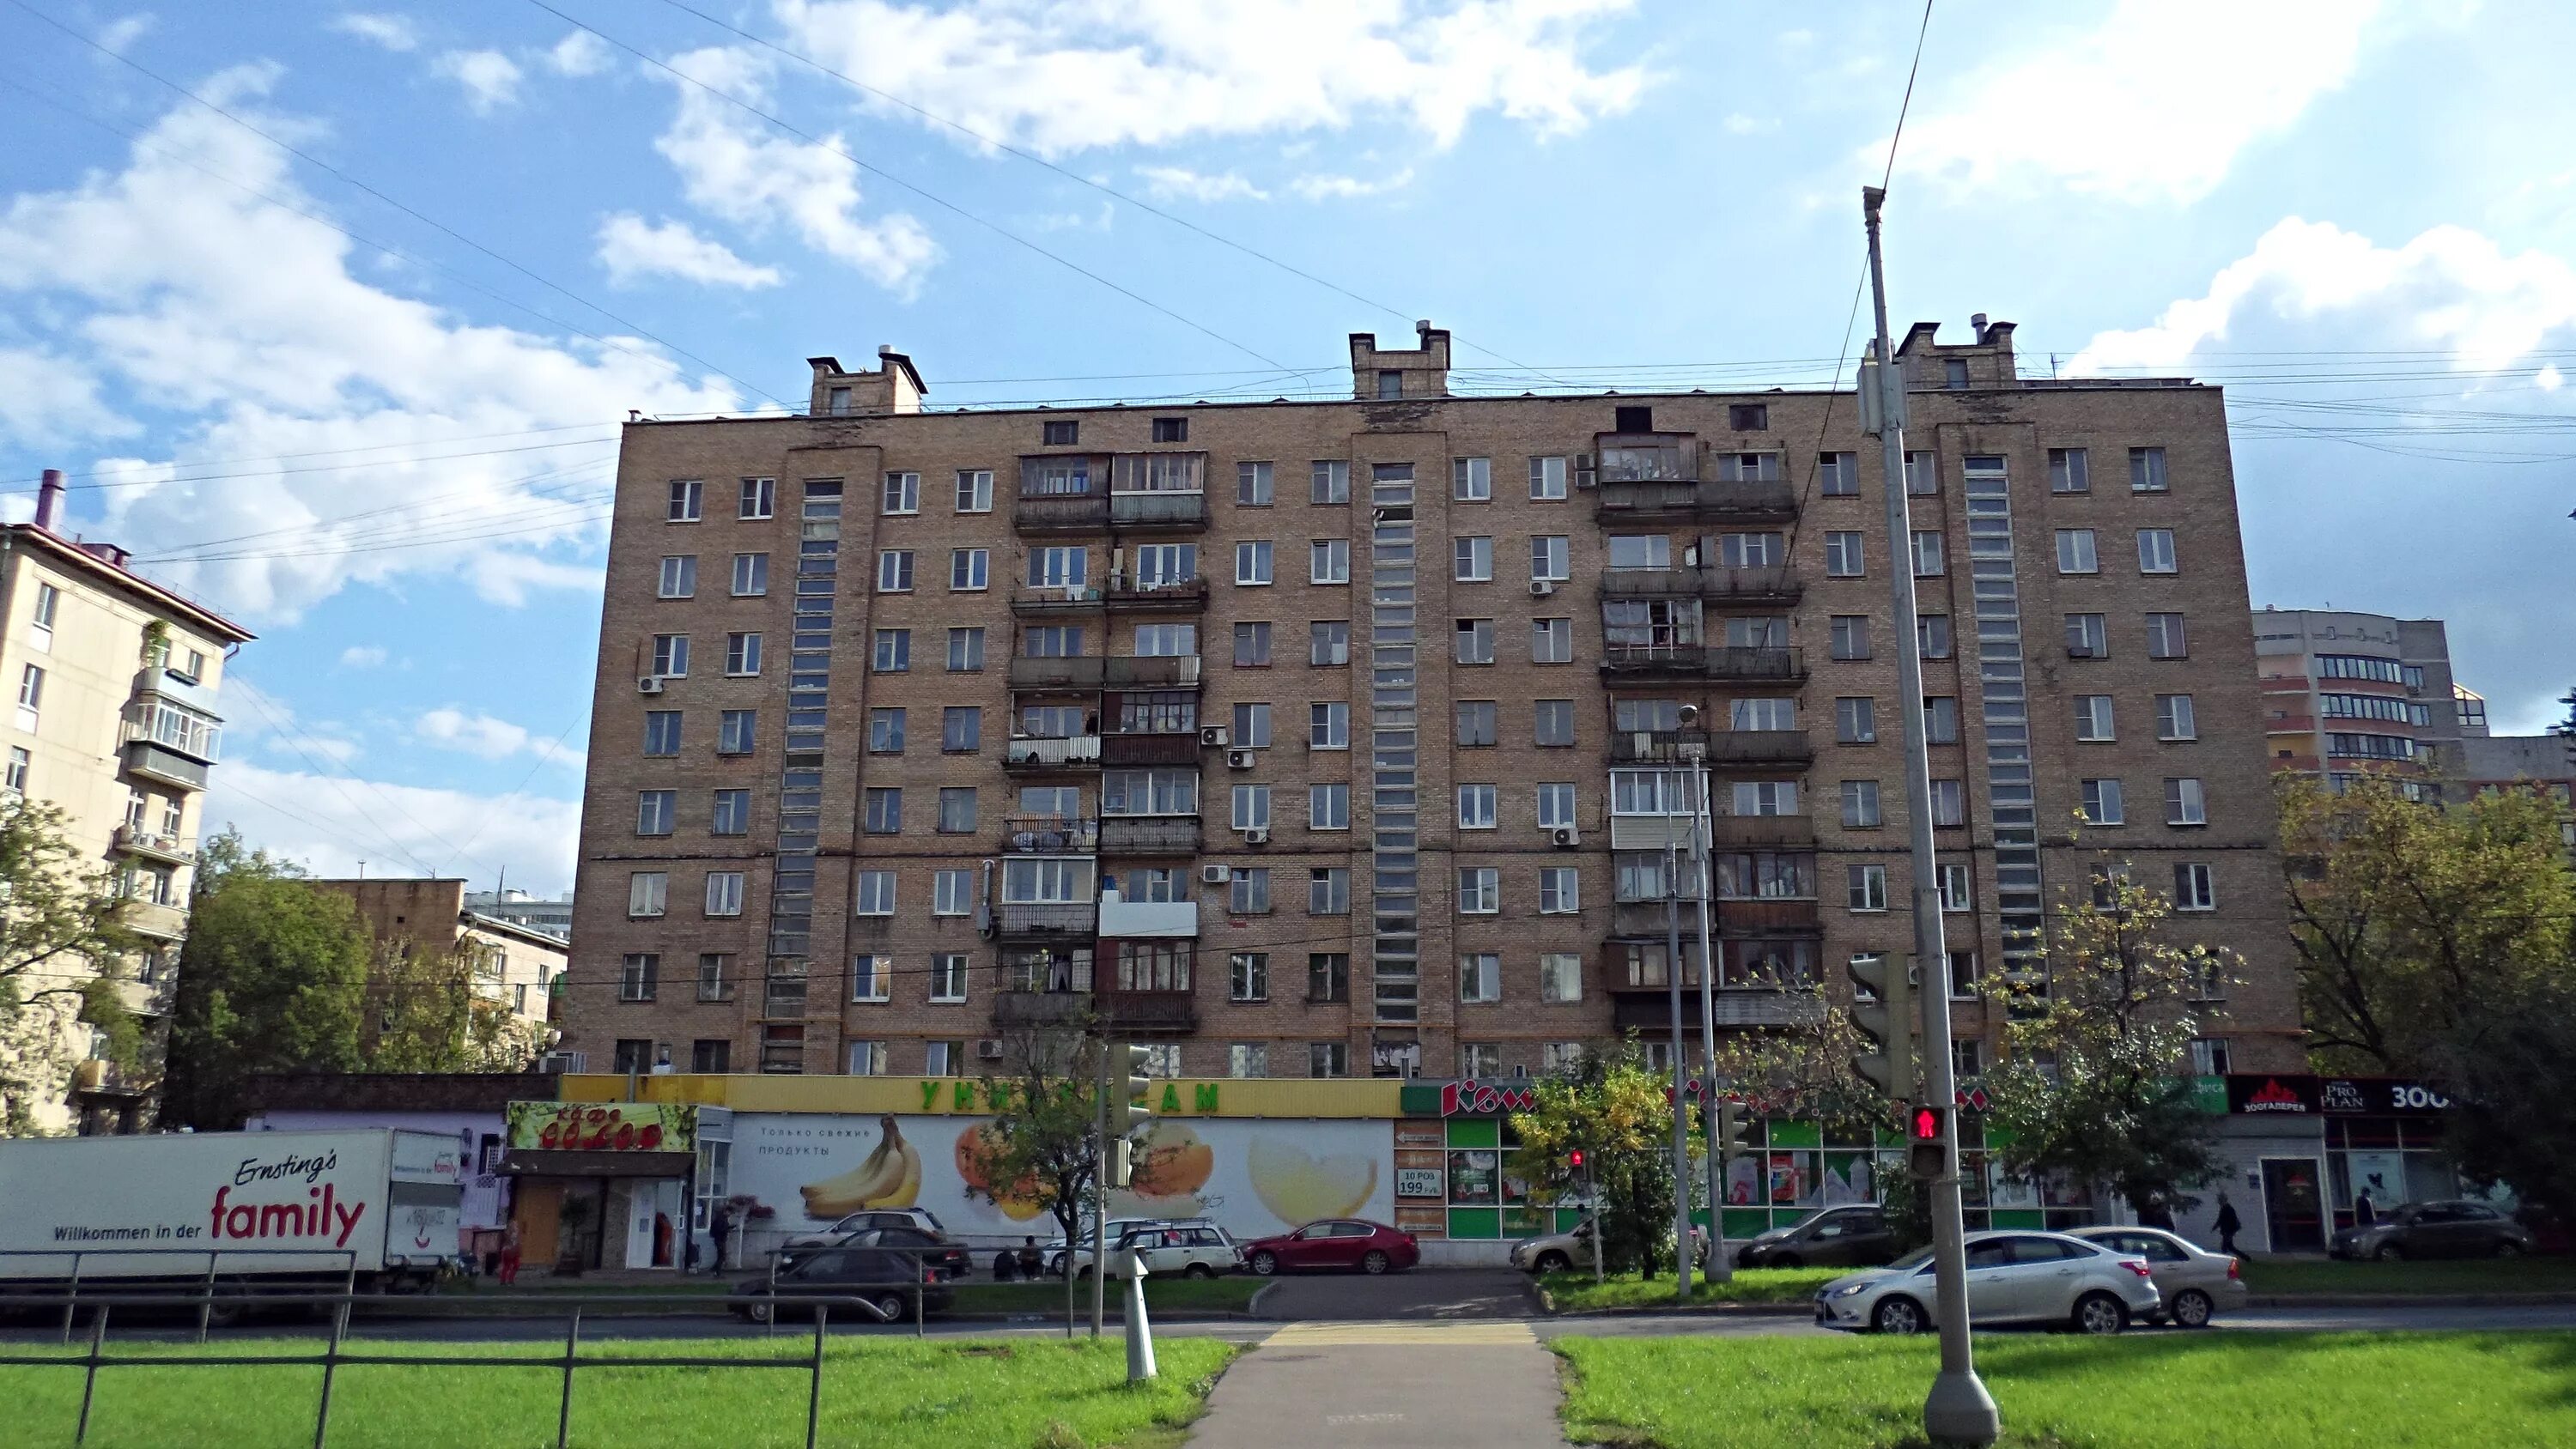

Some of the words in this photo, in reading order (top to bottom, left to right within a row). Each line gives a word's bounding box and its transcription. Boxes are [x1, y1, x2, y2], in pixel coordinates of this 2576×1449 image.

[921, 1081, 1219, 1113] УНИАМ
[2320, 1095, 2364, 1107] PLAN
[758, 1145, 829, 1156] ПРОДУКТЫ
[234, 1148, 337, 1187] Ernsting's
[1405, 1172, 1416, 1180] 10
[1417, 1172, 1436, 1180] РОЗ
[1400, 1181, 1424, 1194] 199
[210, 1182, 366, 1248] family
[54, 1224, 150, 1241] Willkommen
[155, 1223, 171, 1240] in
[175, 1223, 202, 1240] der
